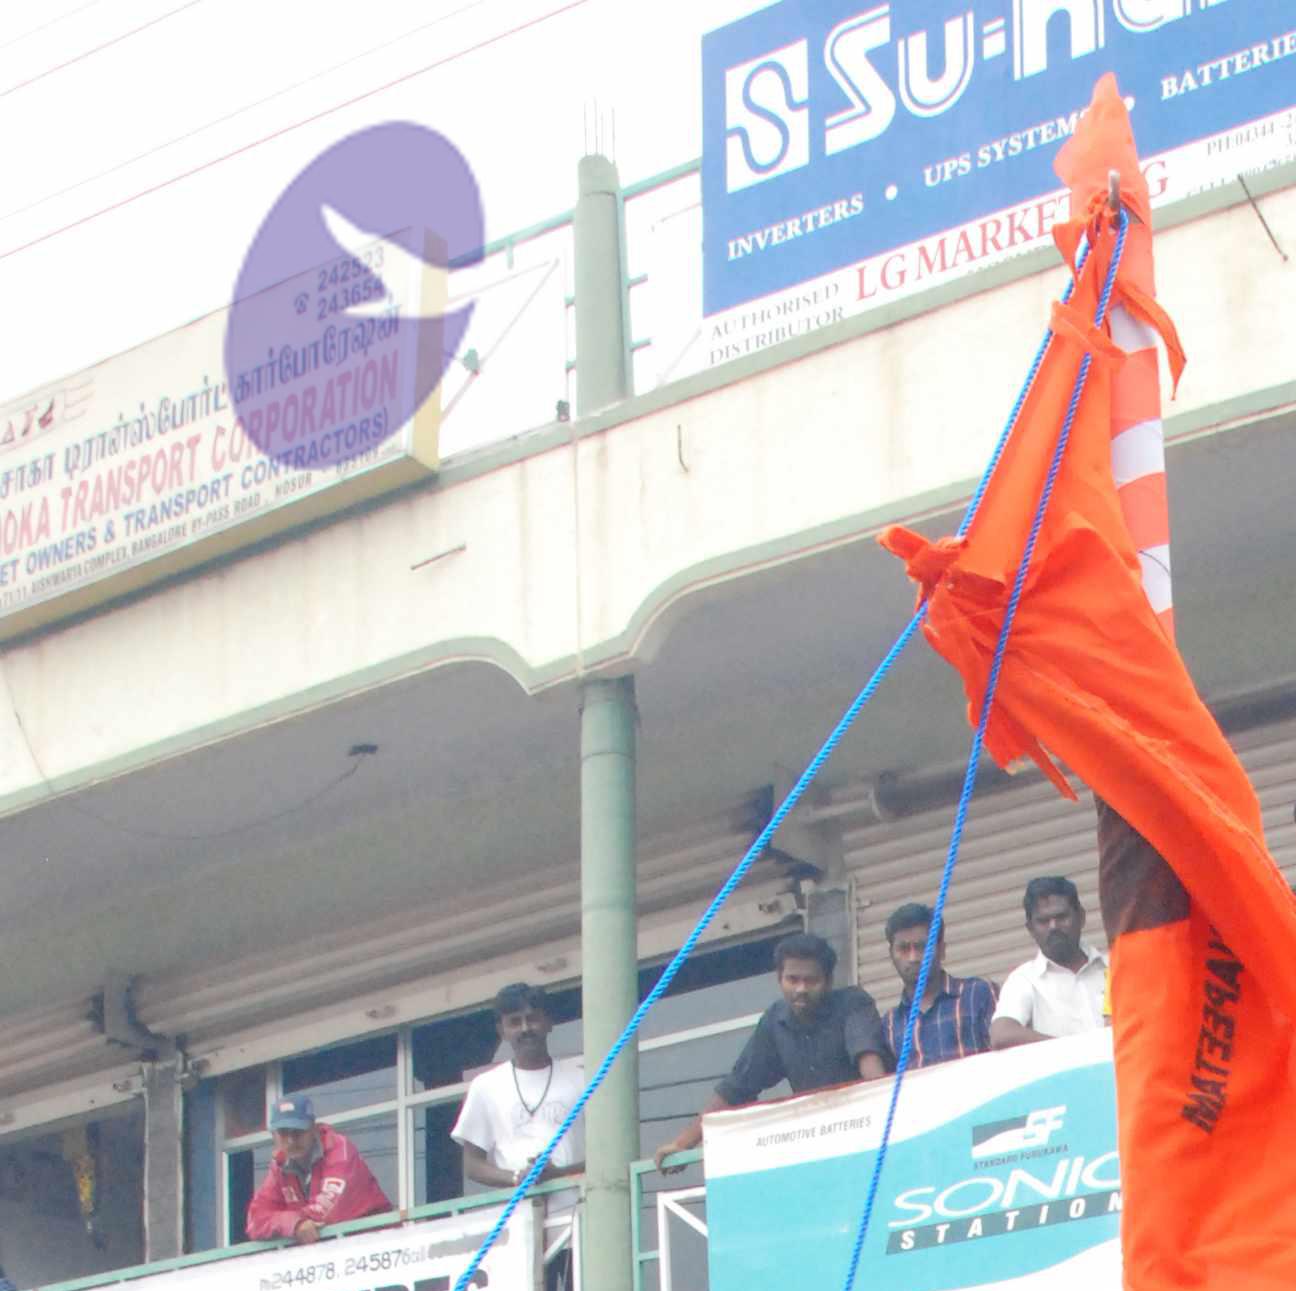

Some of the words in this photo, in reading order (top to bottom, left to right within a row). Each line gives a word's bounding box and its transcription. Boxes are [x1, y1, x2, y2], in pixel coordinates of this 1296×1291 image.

[727, 193, 865, 262] INVERTERS
[923, 146, 973, 188] UPS
[854, 253, 906, 302] LG
[914, 158, 1168, 281] MARKEG
[709, 304, 846, 366] DISTRIBUTOR
[711, 281, 841, 341] AUTHORISED
[60, 432, 202, 535] TRANSPORT
[211, 349, 399, 472] CORPORATION
[25, 526, 97, 575] OWNERS
[103, 519, 116, 544] &
[124, 473, 234, 537] TRANSPORT
[240, 406, 389, 491] CONTRACTORS)
[755, 1126, 817, 1148] AUTOMOTIVE
[819, 1115, 872, 1138] BATTERIES
[973, 1152, 1017, 1171] STANDARD
[900, 1192, 1122, 1250] STATION
